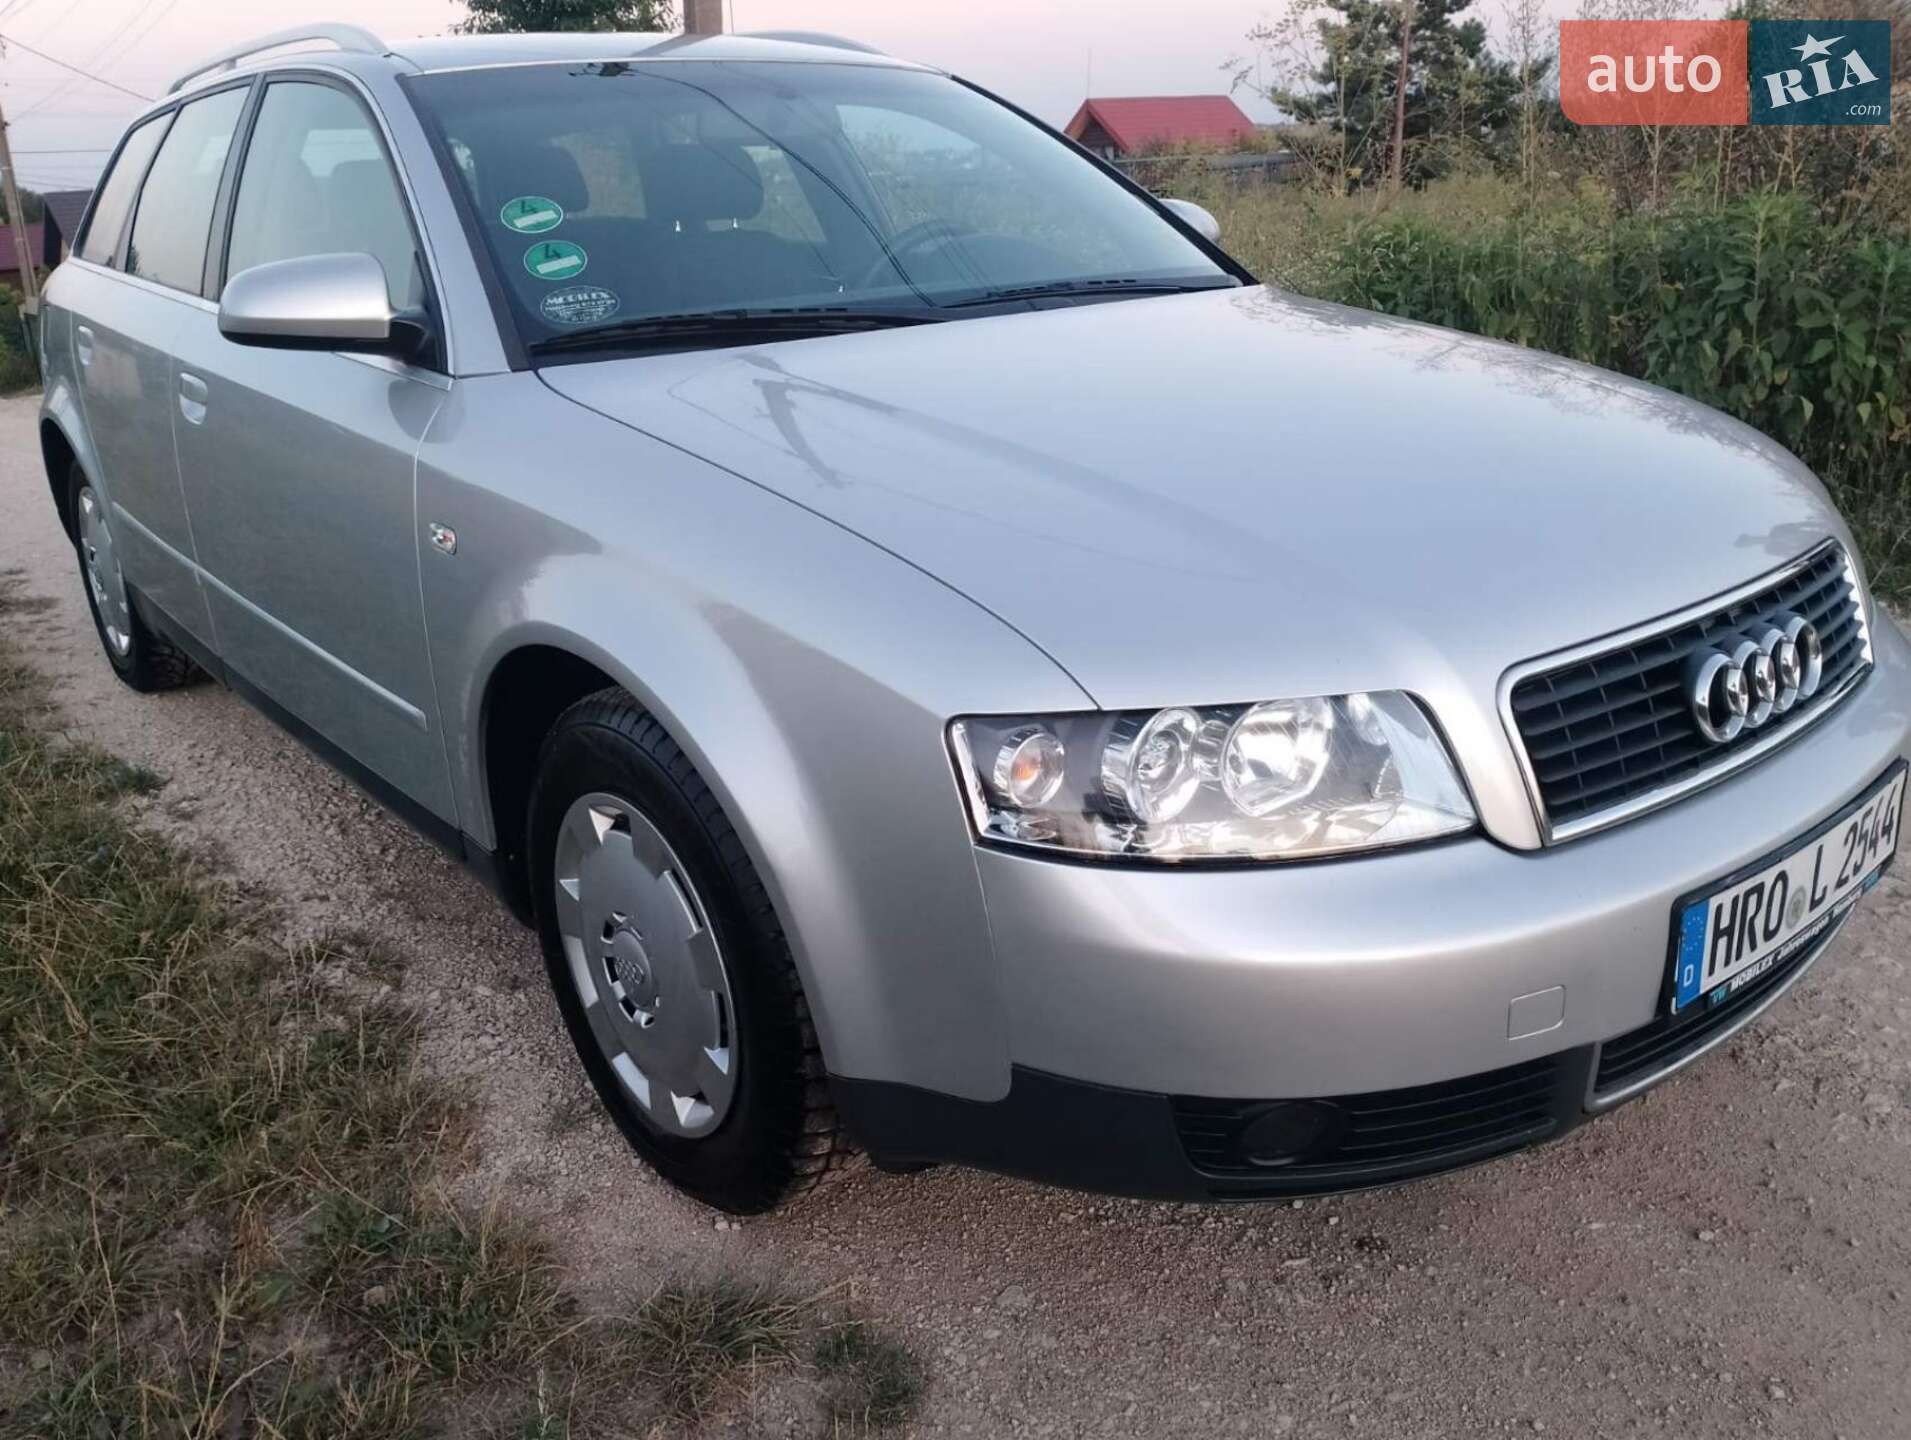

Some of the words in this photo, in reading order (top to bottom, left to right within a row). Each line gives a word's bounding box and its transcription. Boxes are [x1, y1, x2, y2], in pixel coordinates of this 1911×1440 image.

[1708, 869, 1789, 977] HRO
[1809, 844, 1828, 912] L
[1834, 783, 1898, 891] 2544
